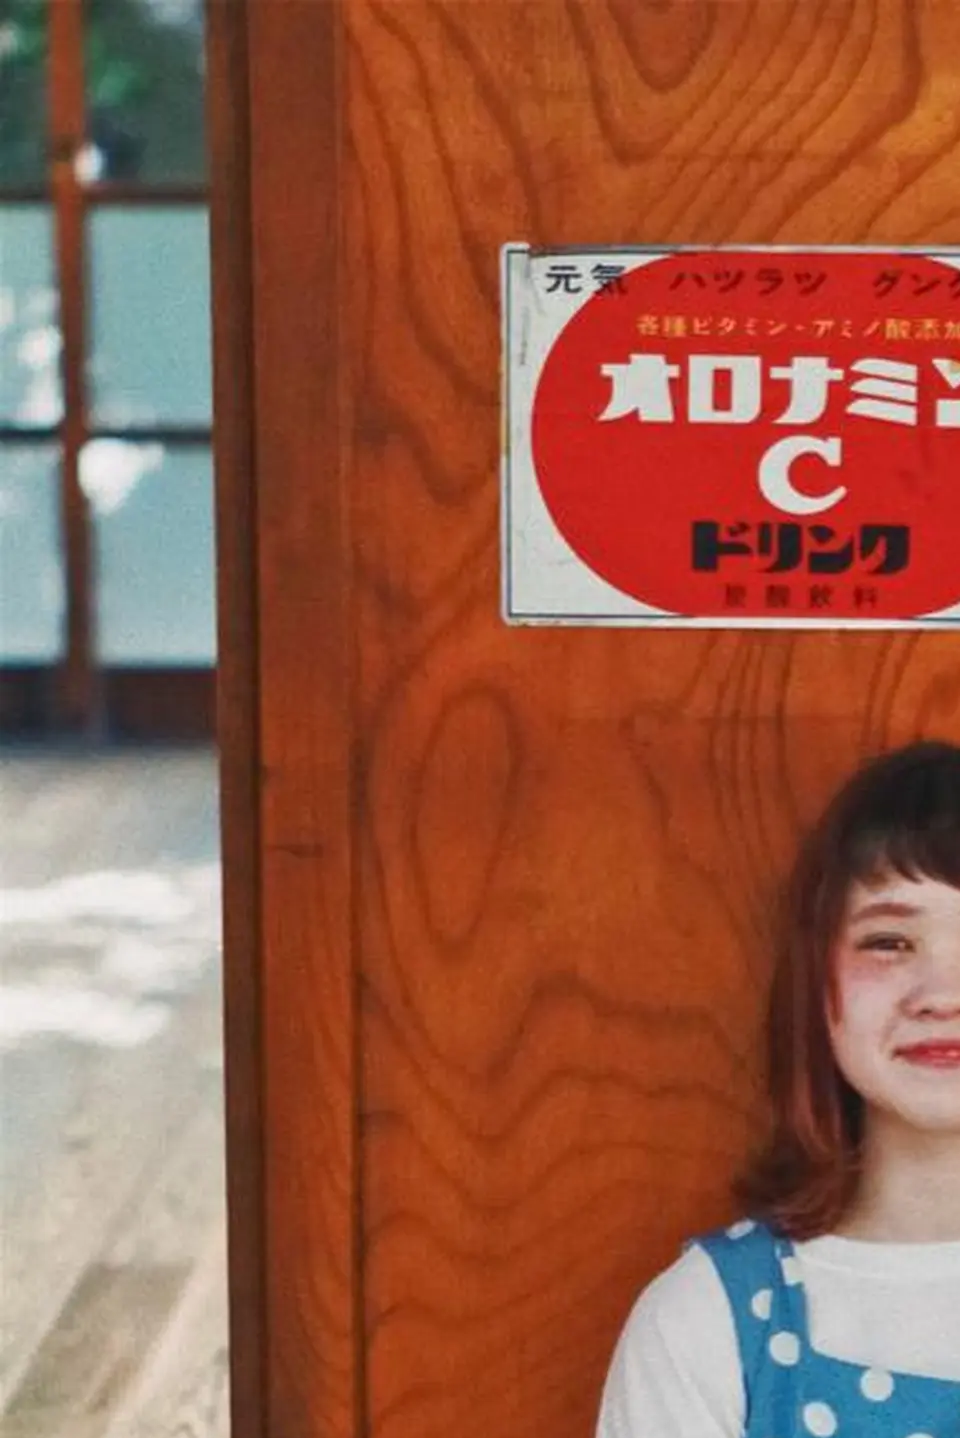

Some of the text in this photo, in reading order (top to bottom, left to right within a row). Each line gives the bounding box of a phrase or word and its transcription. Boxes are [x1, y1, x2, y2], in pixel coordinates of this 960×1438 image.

[546, 264, 629, 296] 元気
[670, 268, 828, 297] ハツラツ
[758, 436, 848, 515] C
[692, 521, 910, 574] ドリンク
